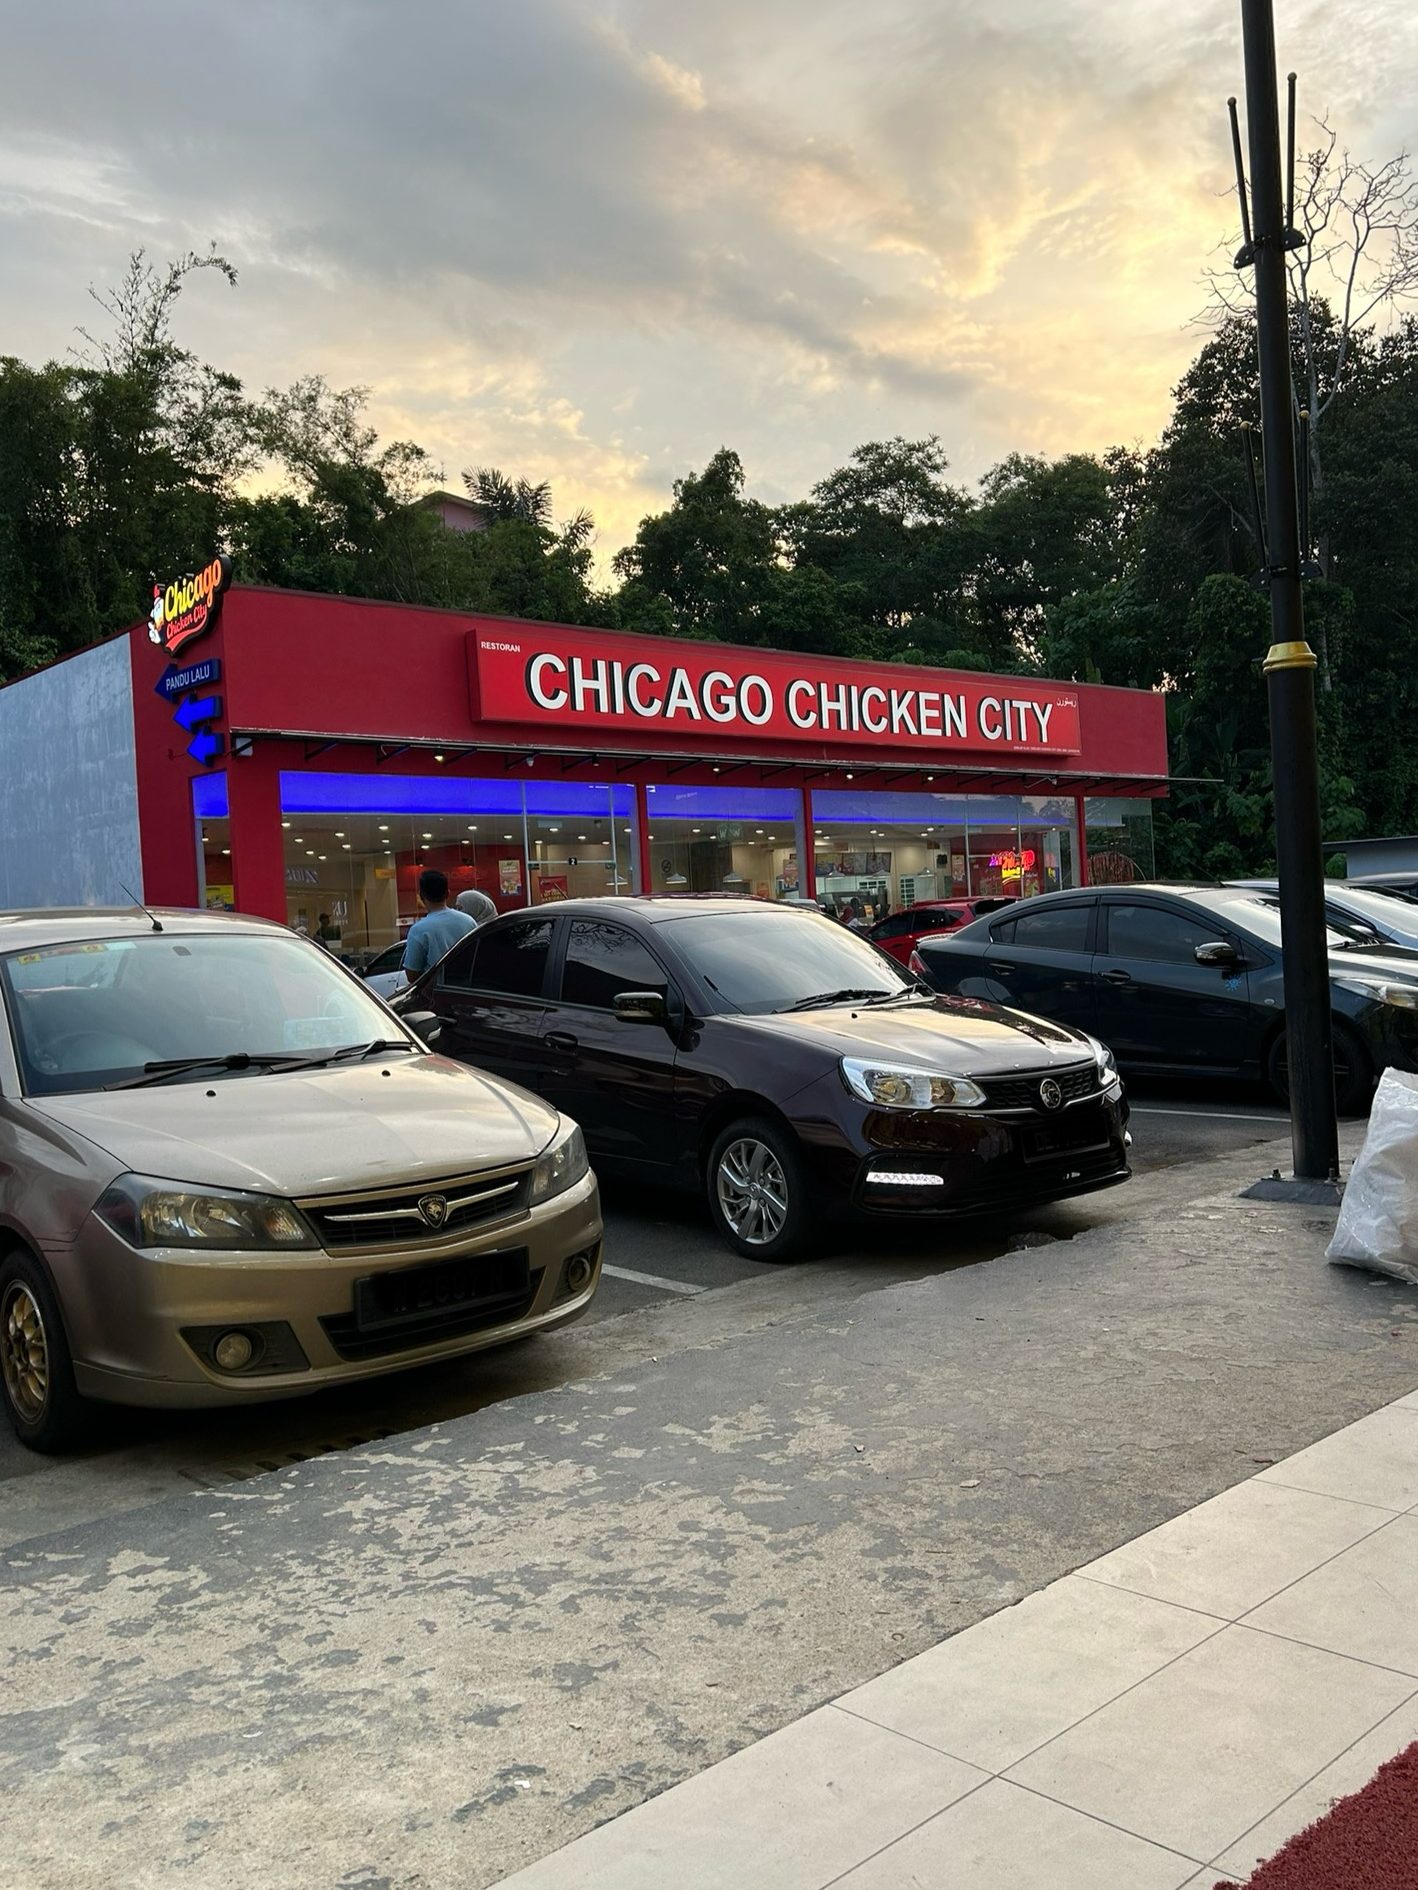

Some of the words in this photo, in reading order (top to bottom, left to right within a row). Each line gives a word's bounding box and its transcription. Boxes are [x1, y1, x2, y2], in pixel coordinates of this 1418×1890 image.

[165, 560, 221, 622] Chicago
[166, 613, 193, 639] Chicken
[193, 603, 208, 624] City
[480, 641, 521, 653] RESTORAN
[166, 672, 190, 691] PANDU
[190, 664, 210, 683] LALU
[526, 652, 774, 726] CHICAGO
[786, 679, 968, 739] CHICKEN
[977, 697, 1053, 743] CITY
